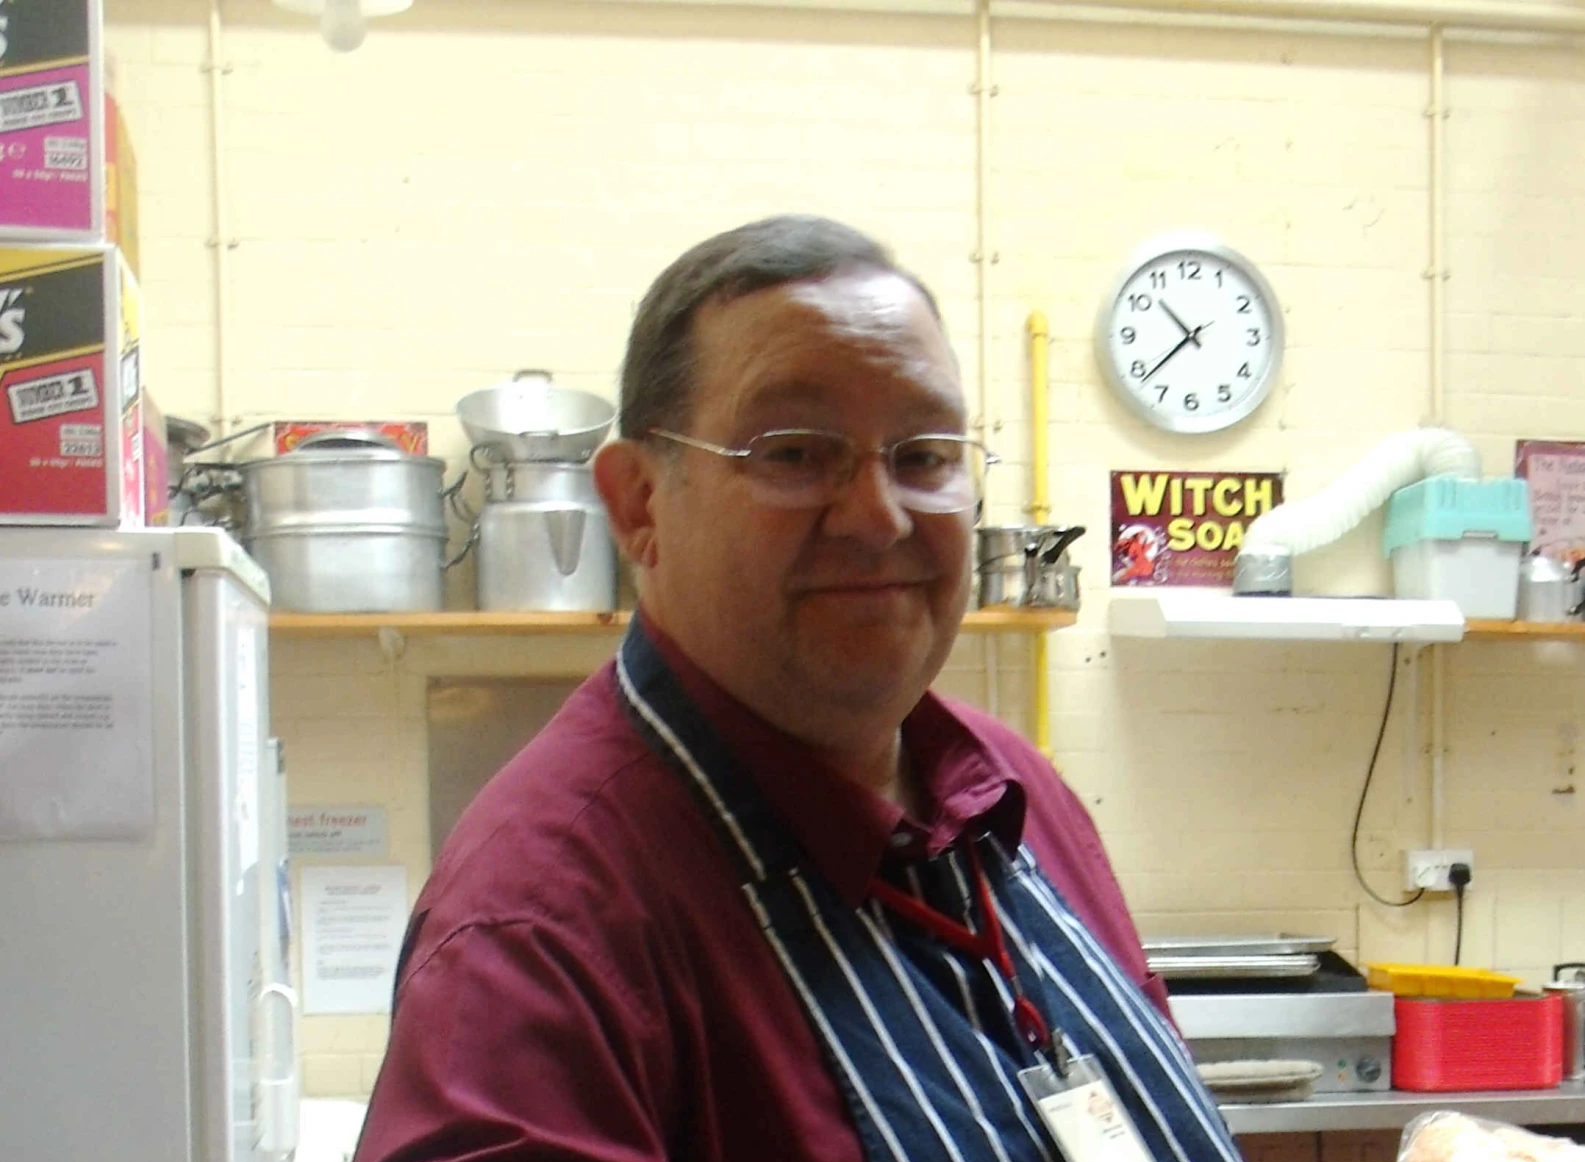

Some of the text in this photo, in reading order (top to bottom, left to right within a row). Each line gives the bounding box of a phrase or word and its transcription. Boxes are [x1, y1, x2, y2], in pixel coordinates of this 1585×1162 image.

[1149, 271, 1166, 289] 11
[1178, 261, 1202, 280] 12
[1214, 269, 1223, 289] 1
[1127, 293, 1152, 312] 10
[1236, 295, 1252, 313] 2
[1120, 326, 1136, 345] 9
[1247, 328, 1261, 346] 3
[1130, 360, 1146, 378] 8
[1236, 361, 1252, 380] 4
[67, 376, 88, 396] 1
[1154, 385, 1169, 403] 7
[1217, 384, 1232, 402] 5
[1183, 392, 1199, 411] 6
[1120, 474, 1273, 517] WITCH
[1168, 518, 1247, 551] SOA
[17, 587, 94, 607] Warmer
[320, 812, 367, 828] freezer
